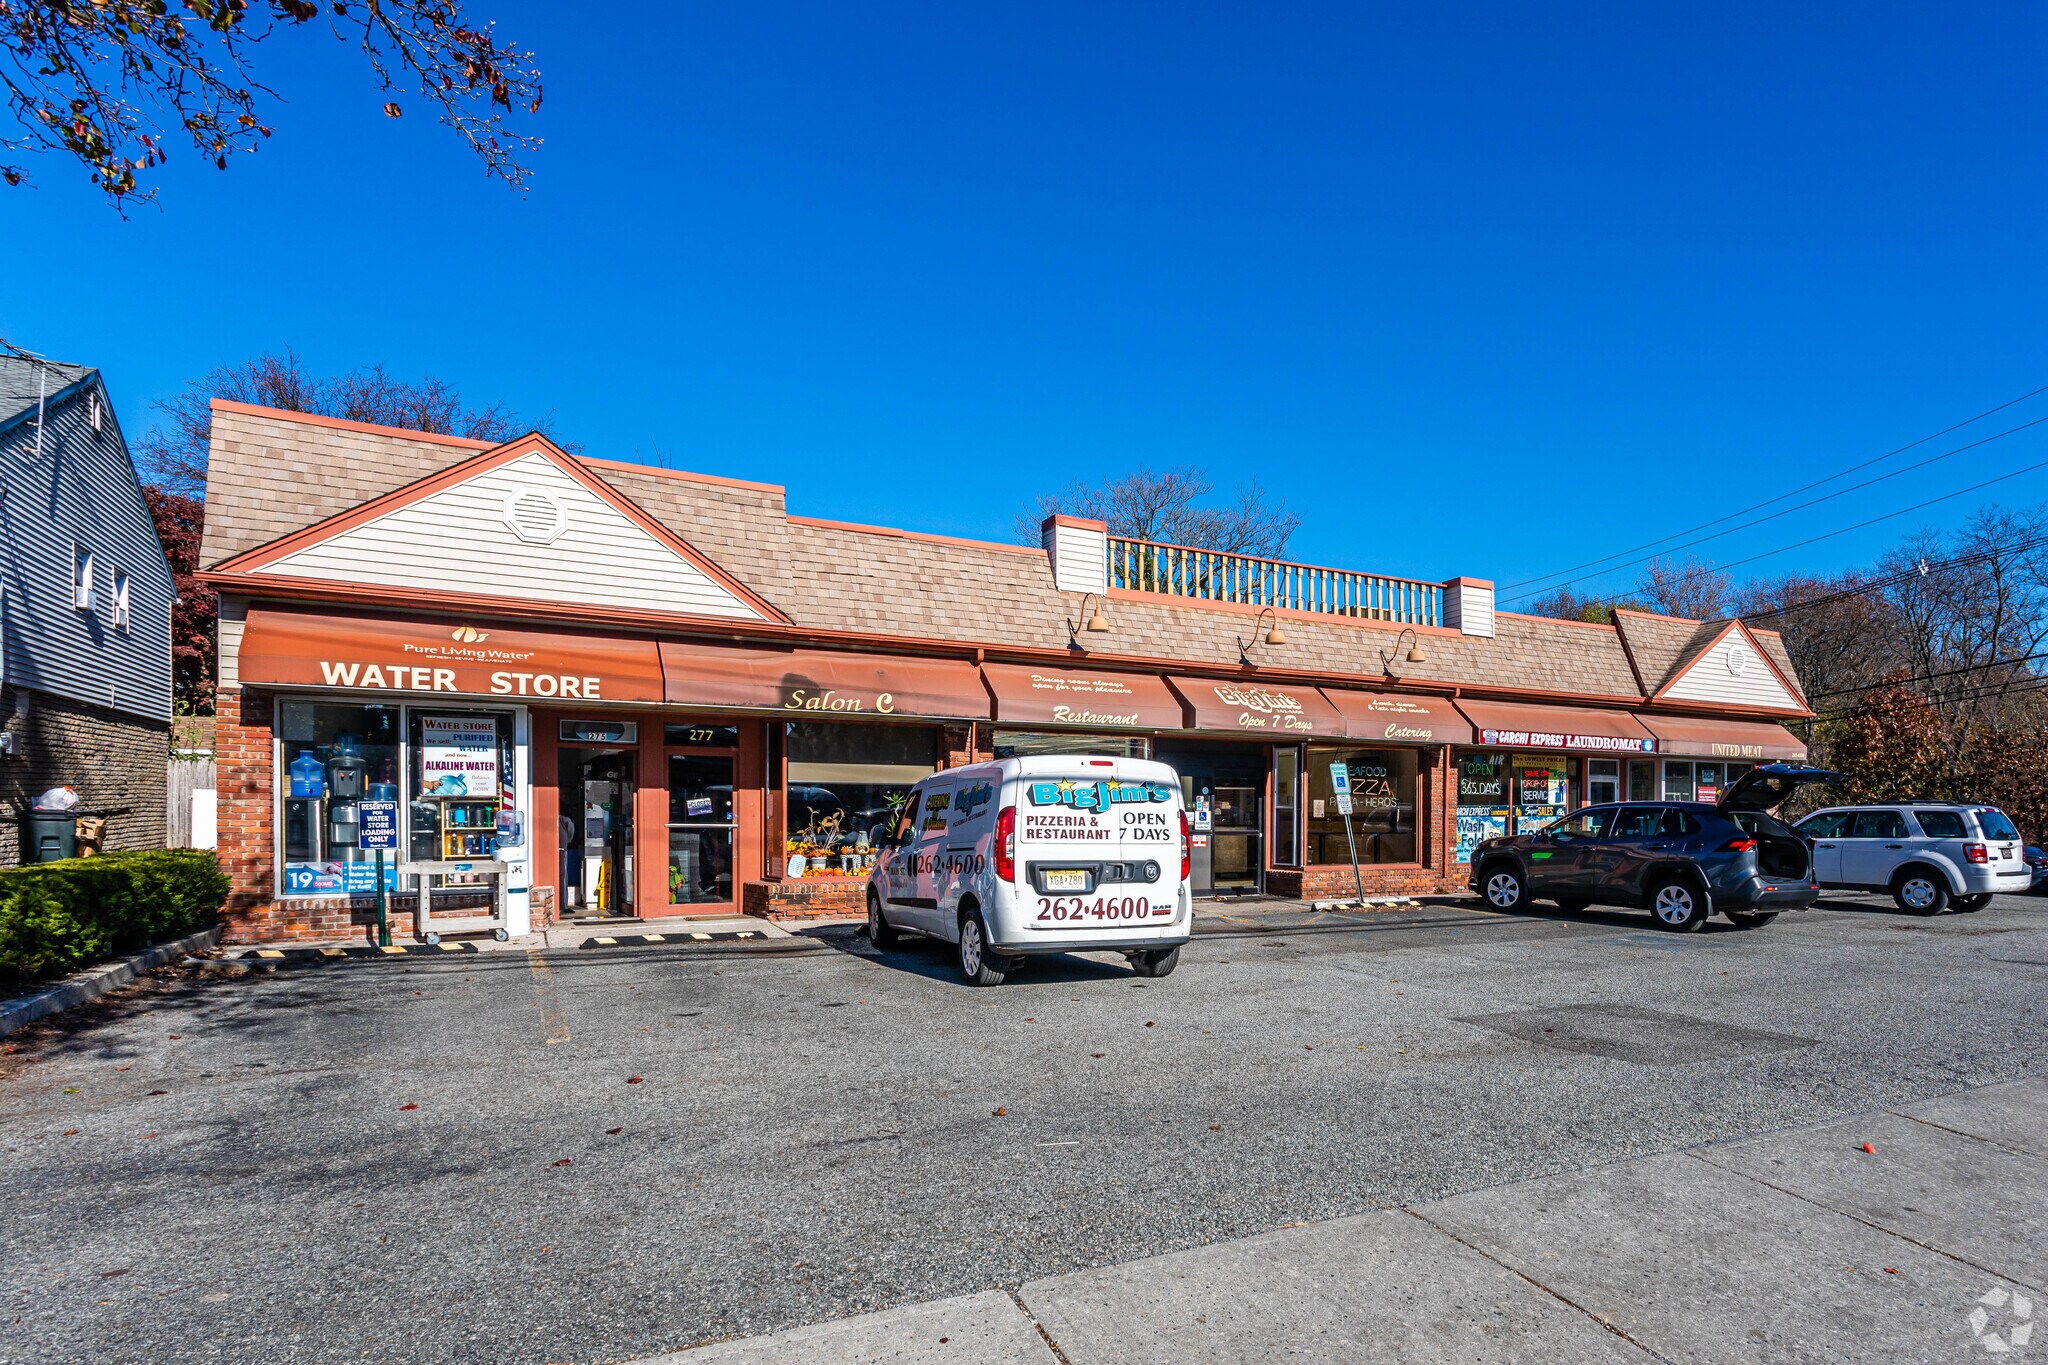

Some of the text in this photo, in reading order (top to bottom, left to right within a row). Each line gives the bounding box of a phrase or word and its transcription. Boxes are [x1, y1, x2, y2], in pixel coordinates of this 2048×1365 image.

[403, 643, 438, 655] Pure
[441, 646, 486, 660] Living
[320, 661, 600, 699] WATER STORE
[1031, 674, 1066, 685] Dining
[1092, 680, 1124, 688] always
[1095, 686, 1133, 694] pleasure
[784, 689, 895, 714] Salon C
[1053, 705, 1138, 725] Restaurant
[1239, 712, 1313, 733] Open 7 Days
[453, 733, 494, 742] PURIFIED
[690, 729, 714, 741] 277
[1384, 723, 1433, 742] Catering
[1530, 732, 1565, 747] EXPRESS
[1566, 735, 1642, 751] LAUNDROMAT
[1712, 743, 1763, 758] UNITED MEAT
[425, 761, 495, 771] ALKALINE WATER
[1489, 754, 1505, 766] AIR
[1348, 766, 1387, 777] EAFOOD
[1468, 763, 1494, 775] OPEN
[1350, 778, 1391, 796] IZZA
[1461, 782, 1477, 794] 365
[1523, 779, 1548, 788] DROP-OF
[1523, 790, 1548, 801] SERVIC
[1365, 797, 1397, 808] HEROS
[1538, 807, 1554, 816] SALES
[1026, 815, 1099, 827] PIZZERIA &
[1123, 811, 1166, 825] OPEN
[1457, 820, 1484, 833] Wash
[1026, 828, 1111, 840] RESTAURANT
[1119, 828, 1170, 841] 7 DAYS
[1461, 833, 1484, 847] Fold
[1049, 875, 1083, 885] XGA Z80
